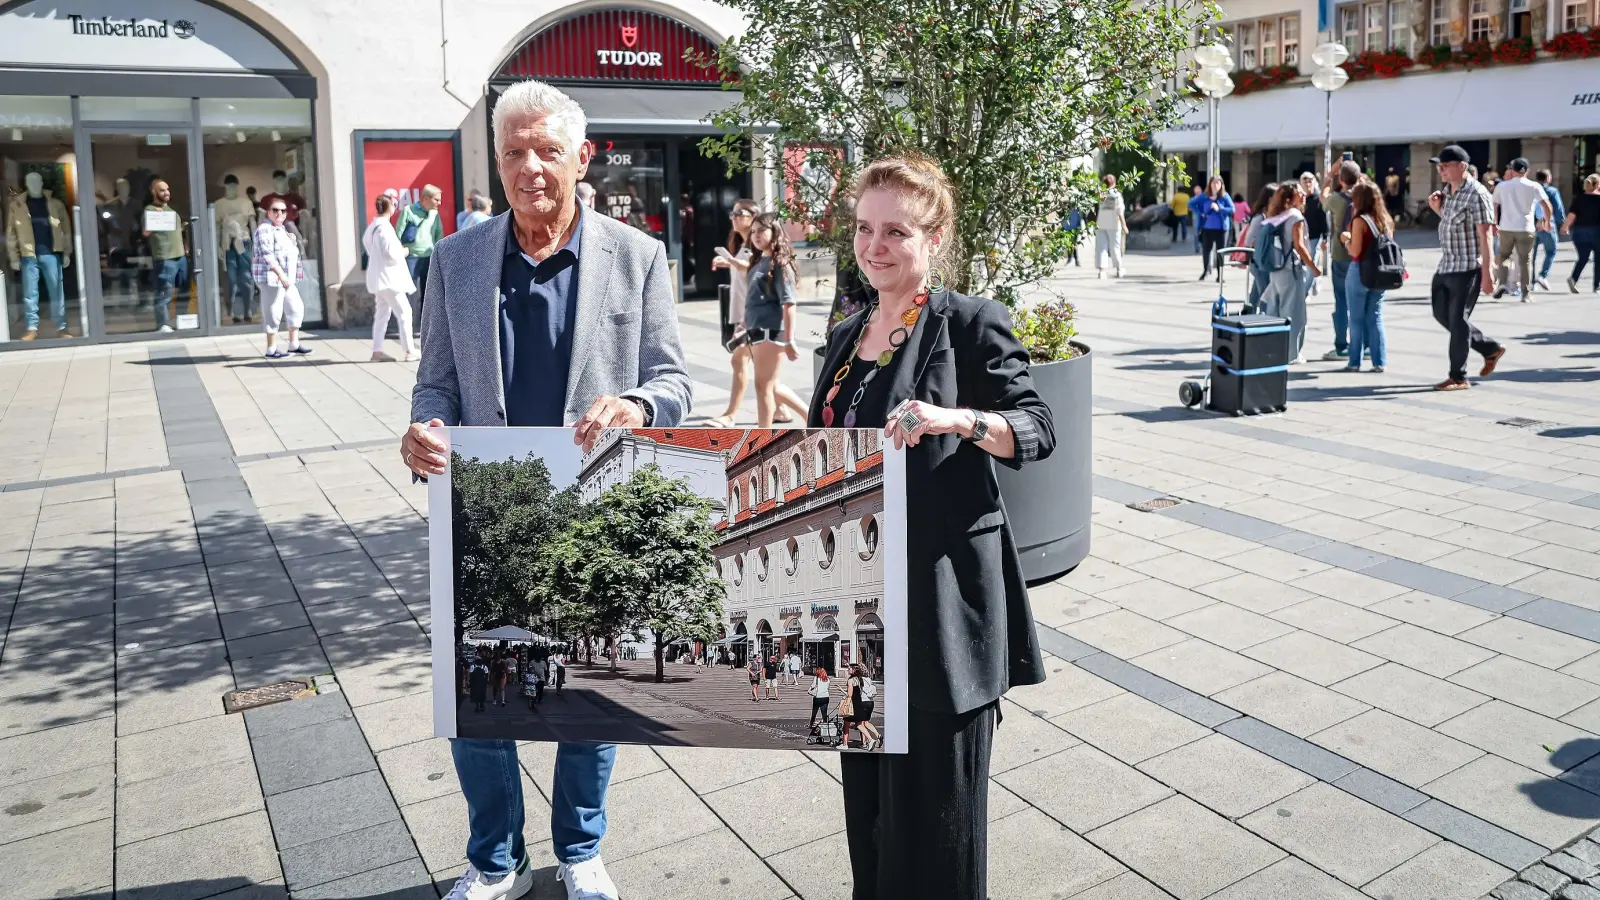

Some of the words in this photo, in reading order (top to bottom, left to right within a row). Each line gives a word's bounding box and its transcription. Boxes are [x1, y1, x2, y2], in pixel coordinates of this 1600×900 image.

[67, 14, 168, 38] Timberland
[597, 50, 662, 66] TUDOR
[618, 195, 632, 205] TO
